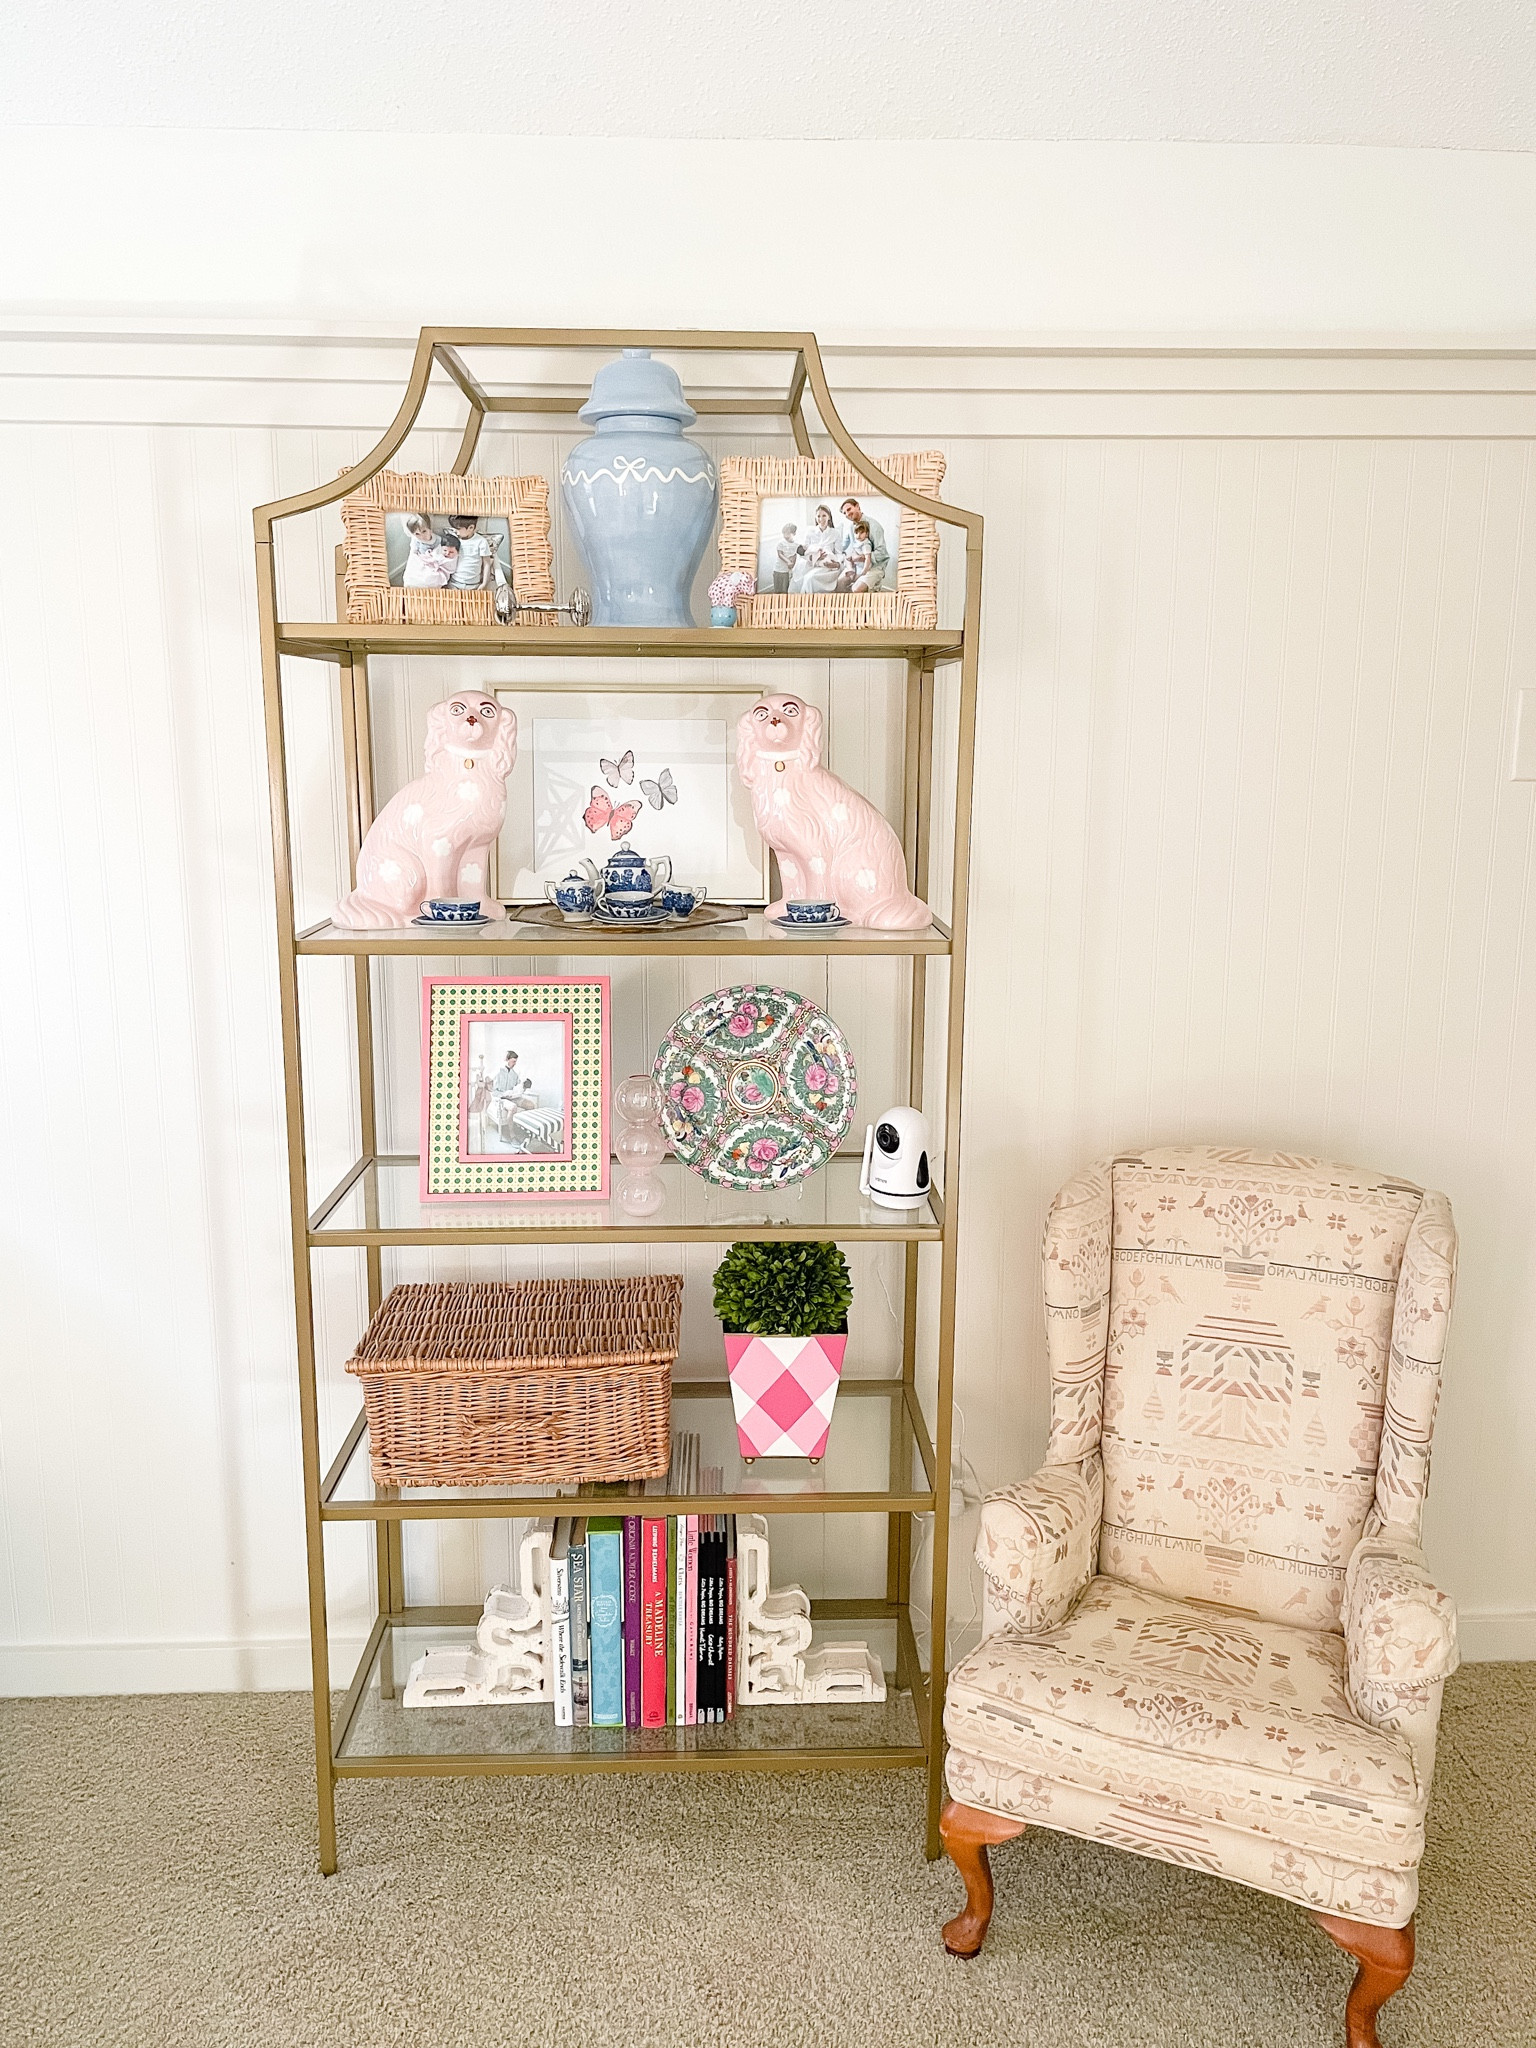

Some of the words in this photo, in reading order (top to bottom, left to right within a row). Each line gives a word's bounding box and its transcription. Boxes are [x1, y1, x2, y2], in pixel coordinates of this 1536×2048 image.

[628, 1520, 636, 1550] ORIGINAL
[571, 1553, 583, 1574] SEA
[628, 1551, 636, 1579] MOTHER
[688, 1547, 697, 1572] Women
[574, 1577, 584, 1602] STAR
[628, 1580, 636, 1603] GOOSE
[645, 1602, 653, 1647] TREASURY
[654, 1599, 664, 1657] MADELINE
[559, 1679, 567, 1694] Ends
